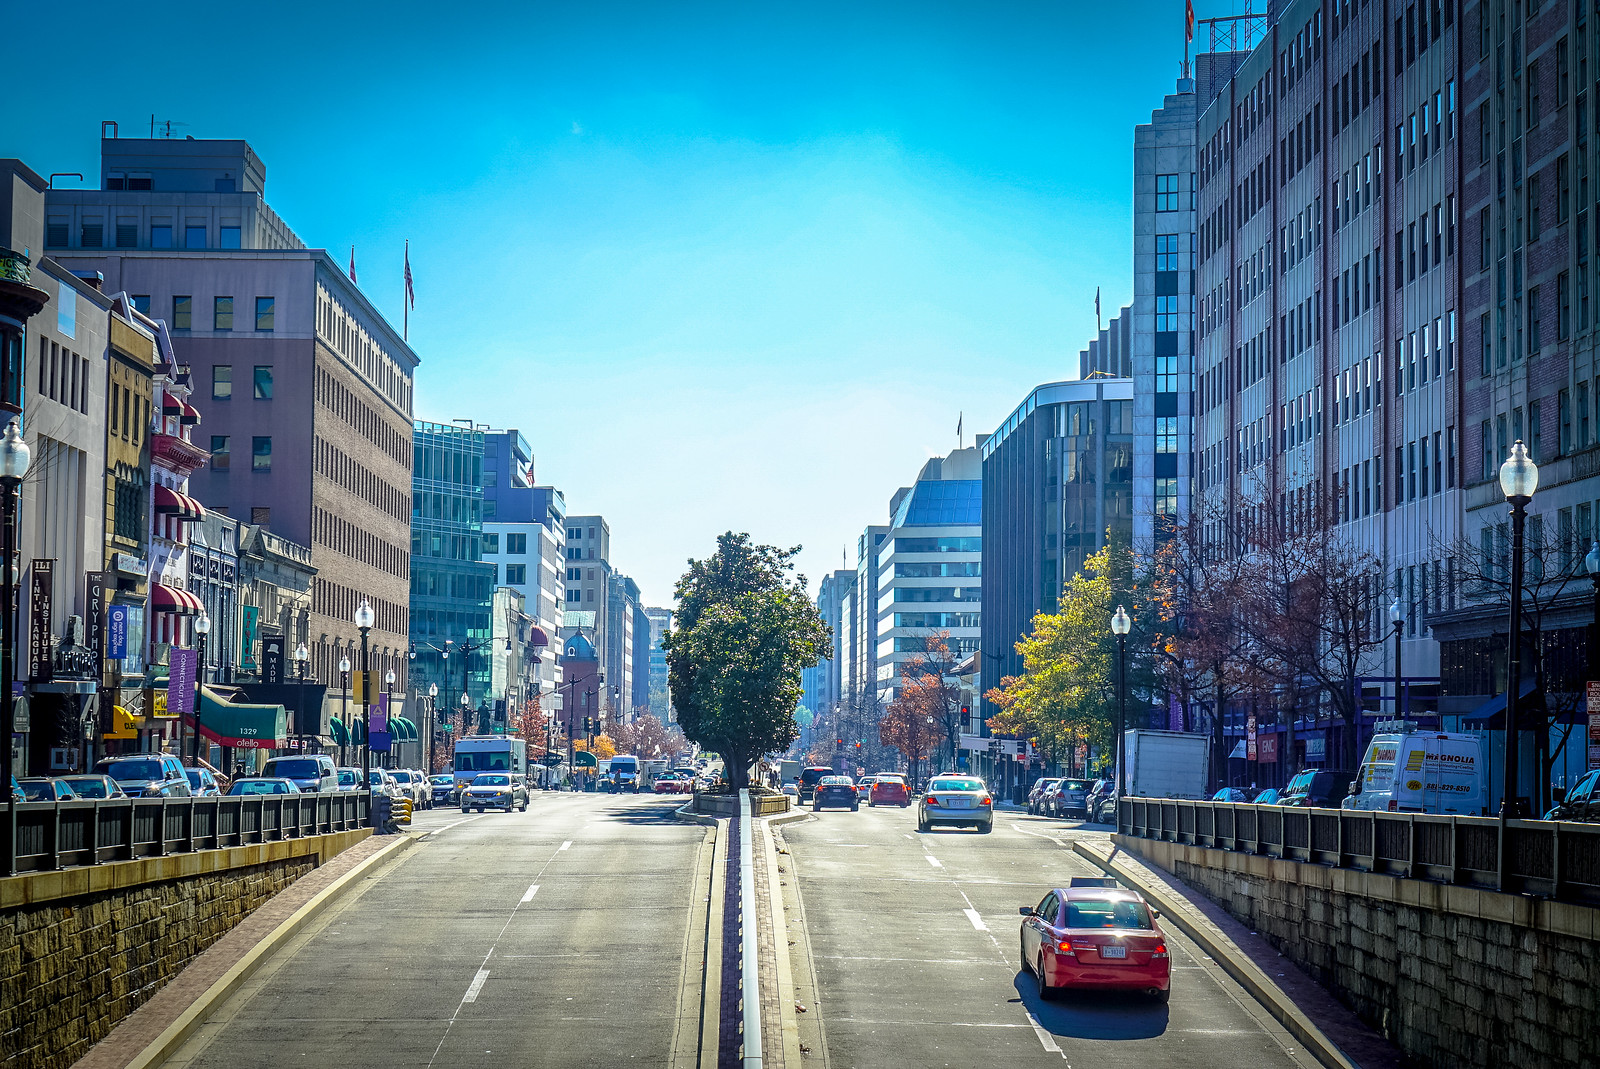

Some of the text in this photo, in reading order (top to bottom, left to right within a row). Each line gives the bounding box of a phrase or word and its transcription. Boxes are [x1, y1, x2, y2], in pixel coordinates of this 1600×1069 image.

[35, 561, 50, 569] ILI
[117, 635, 125, 647] day
[32, 619, 40, 677] LANGUAGE
[179, 653, 187, 698] CONNECTICUT
[240, 727, 258, 735] 1329
[236, 739, 259, 748] otello
[1426, 753, 1475, 764] MAGNOLIA
